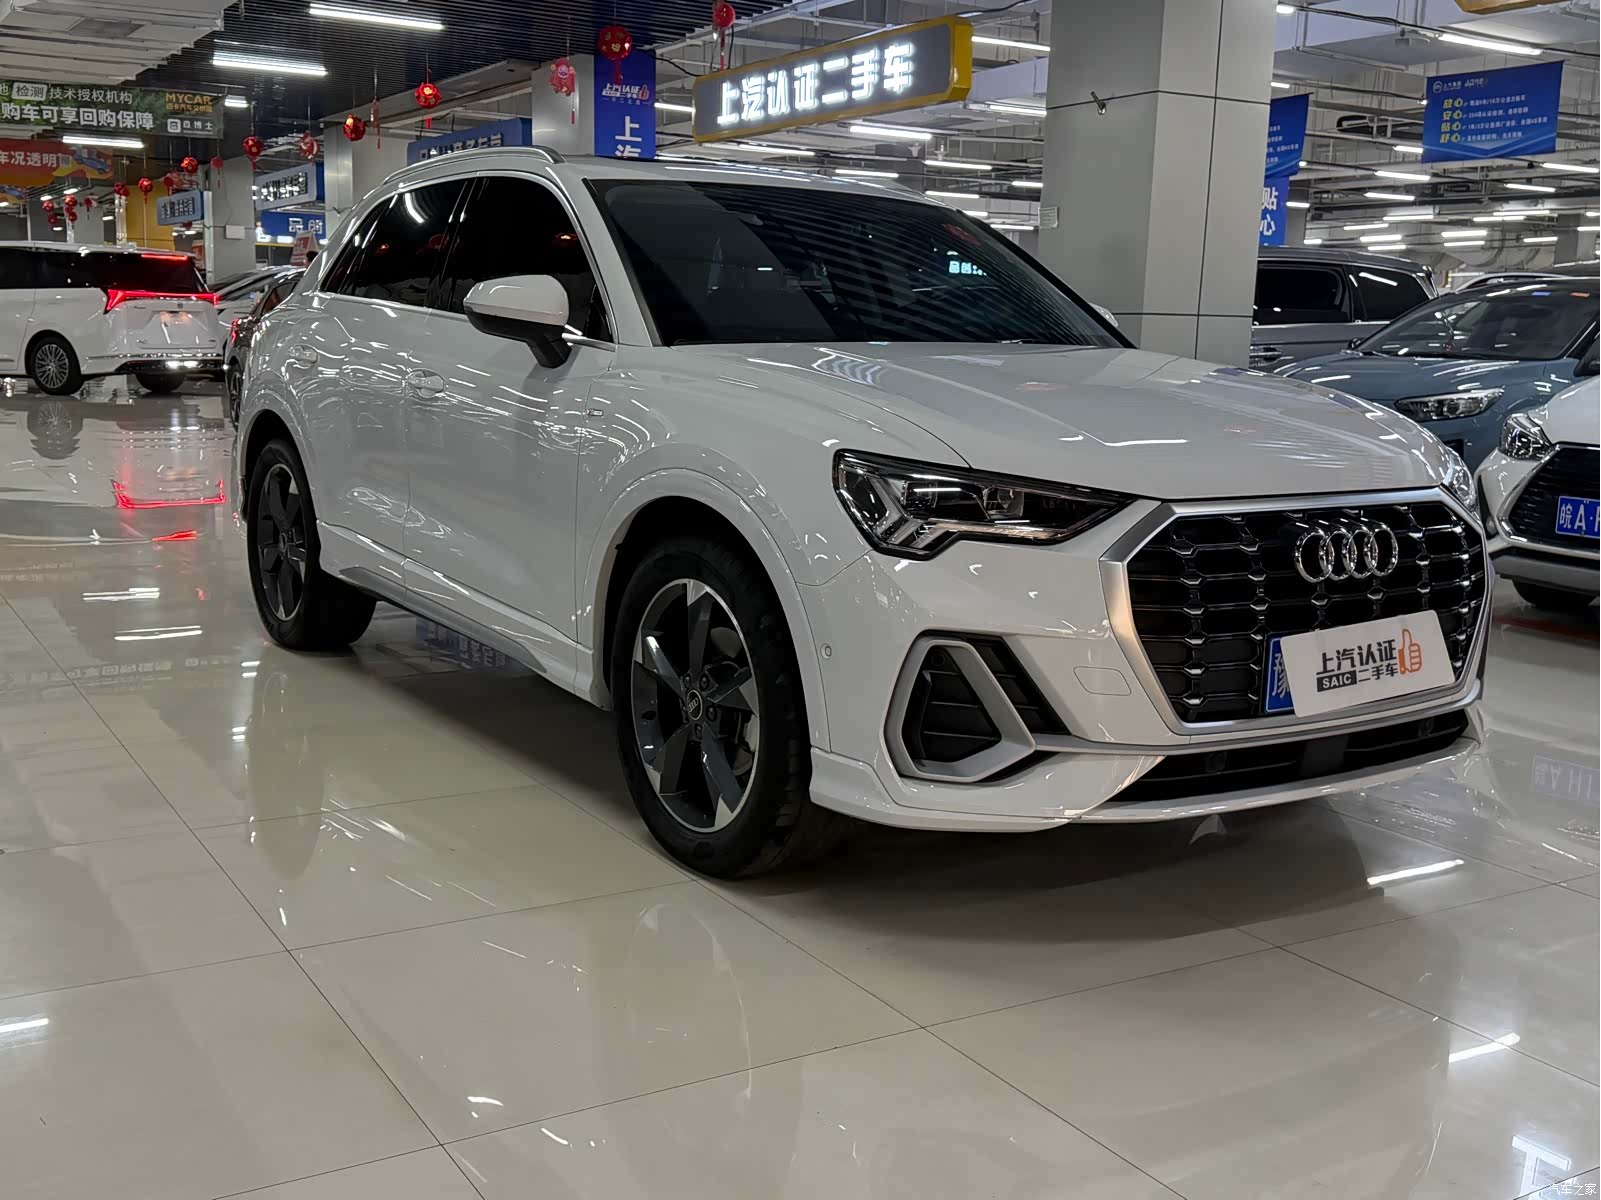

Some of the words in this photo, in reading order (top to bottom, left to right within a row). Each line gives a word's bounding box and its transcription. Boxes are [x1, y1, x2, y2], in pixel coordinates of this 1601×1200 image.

[165, 92, 212, 105] MYCAR
[717, 43, 913, 126] 上汽认证二手车
[1, 102, 154, 130] 购车可享回购保障
[1316, 639, 1396, 675] 上汽认证
[1322, 673, 1352, 689] SAIC
[1358, 662, 1399, 682] 二手车
